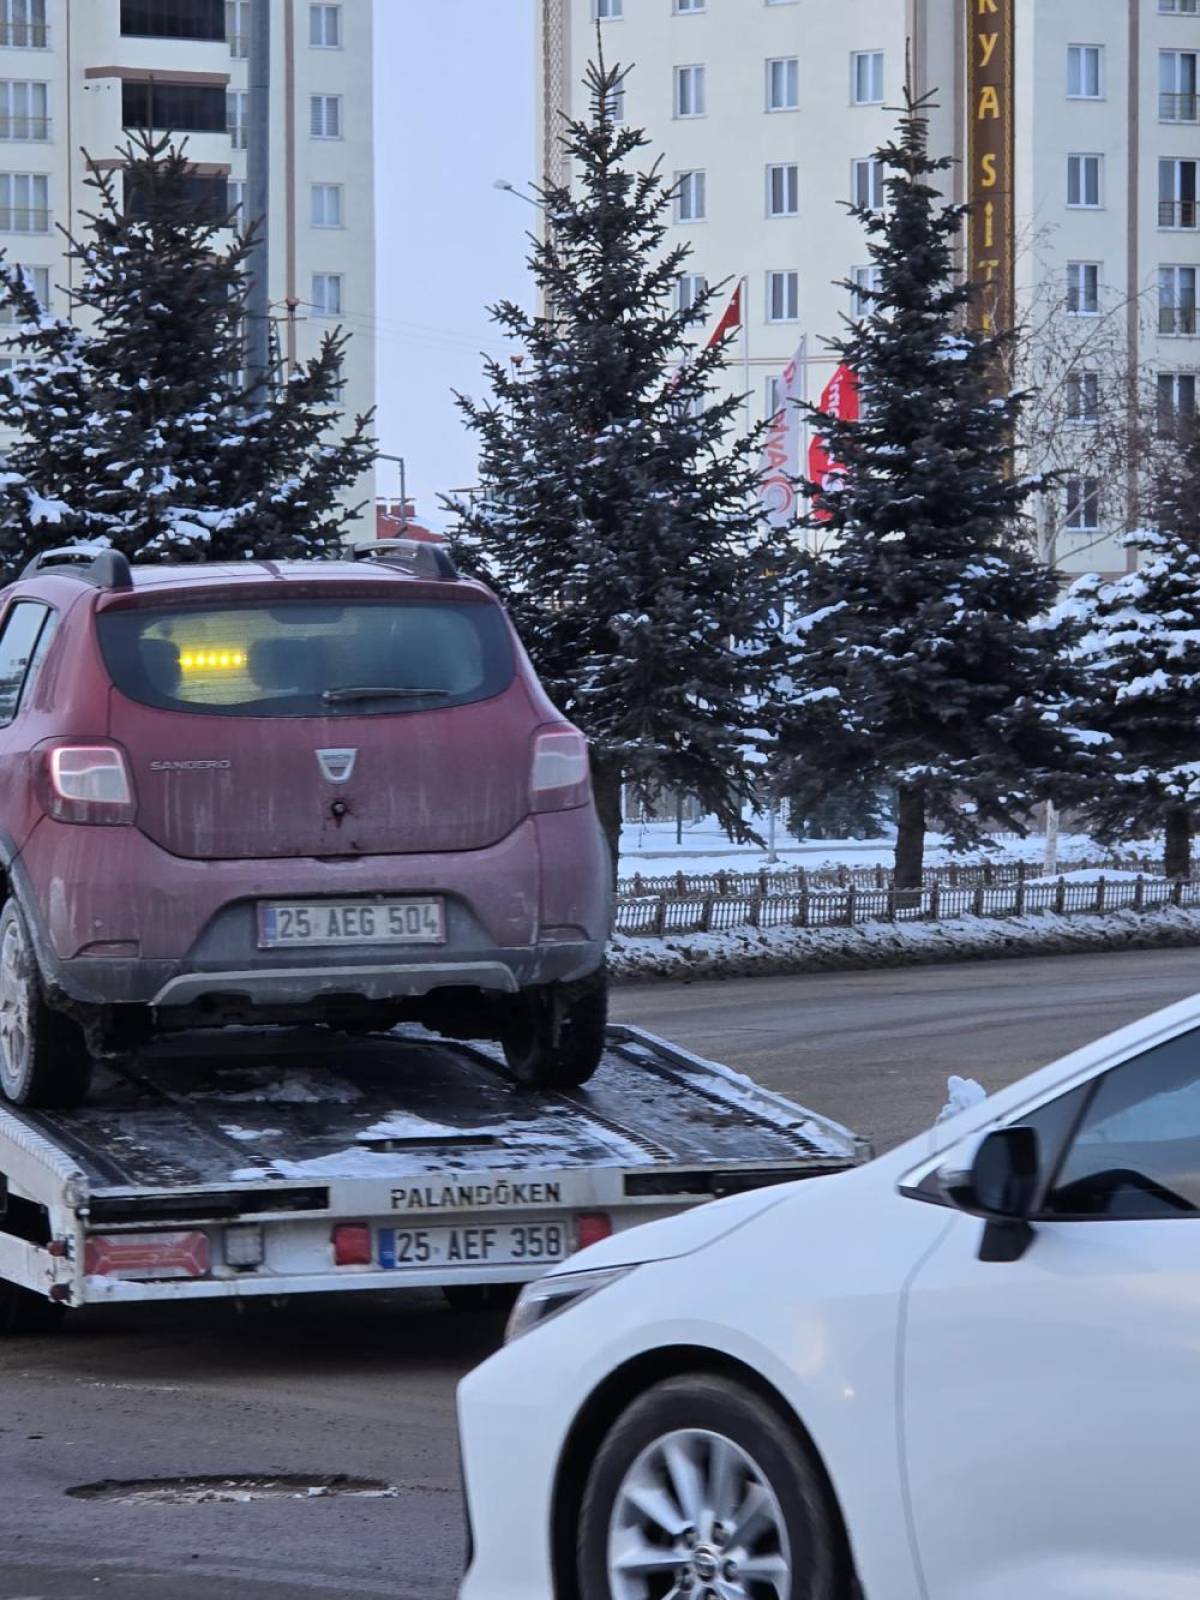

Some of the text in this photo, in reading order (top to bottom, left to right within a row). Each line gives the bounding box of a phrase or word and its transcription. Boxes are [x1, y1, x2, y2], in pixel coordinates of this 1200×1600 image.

[150, 760, 232, 771] SANDERO
[278, 905, 437, 939] 25 AEG 504
[391, 1180, 561, 1209] PALANDÖKEN
[397, 1226, 561, 1263] 25 AEF 358
